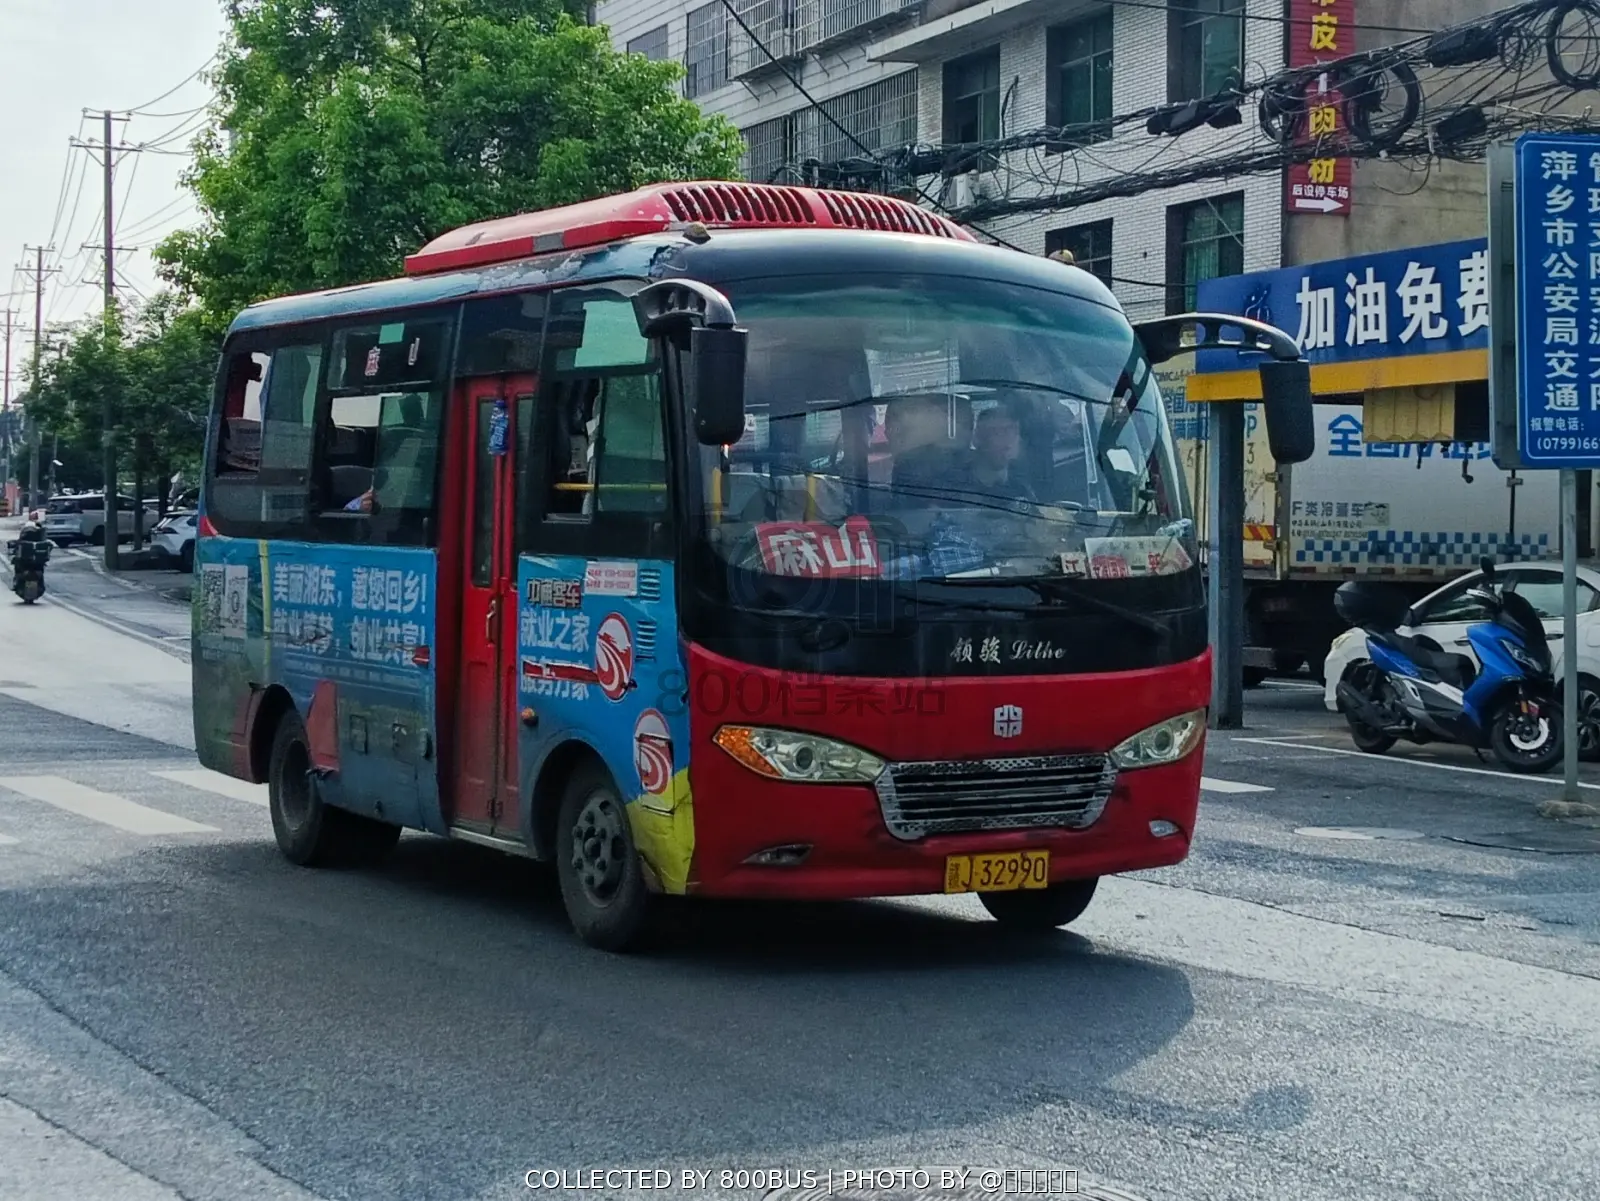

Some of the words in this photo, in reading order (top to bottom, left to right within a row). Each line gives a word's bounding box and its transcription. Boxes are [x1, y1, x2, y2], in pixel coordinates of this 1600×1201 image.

[1292, 184, 1349, 199] 后设停车场
[1295, 250, 1490, 350] 加油免费
[1540, 150, 1581, 412] 萍乡市公安局交通
[1529, 416, 1585, 431] 报警电话:
[1536, 437, 1600, 451] (0799)66
[767, 523, 877, 577] 麻山
[520, 607, 590, 653] 就业之家
